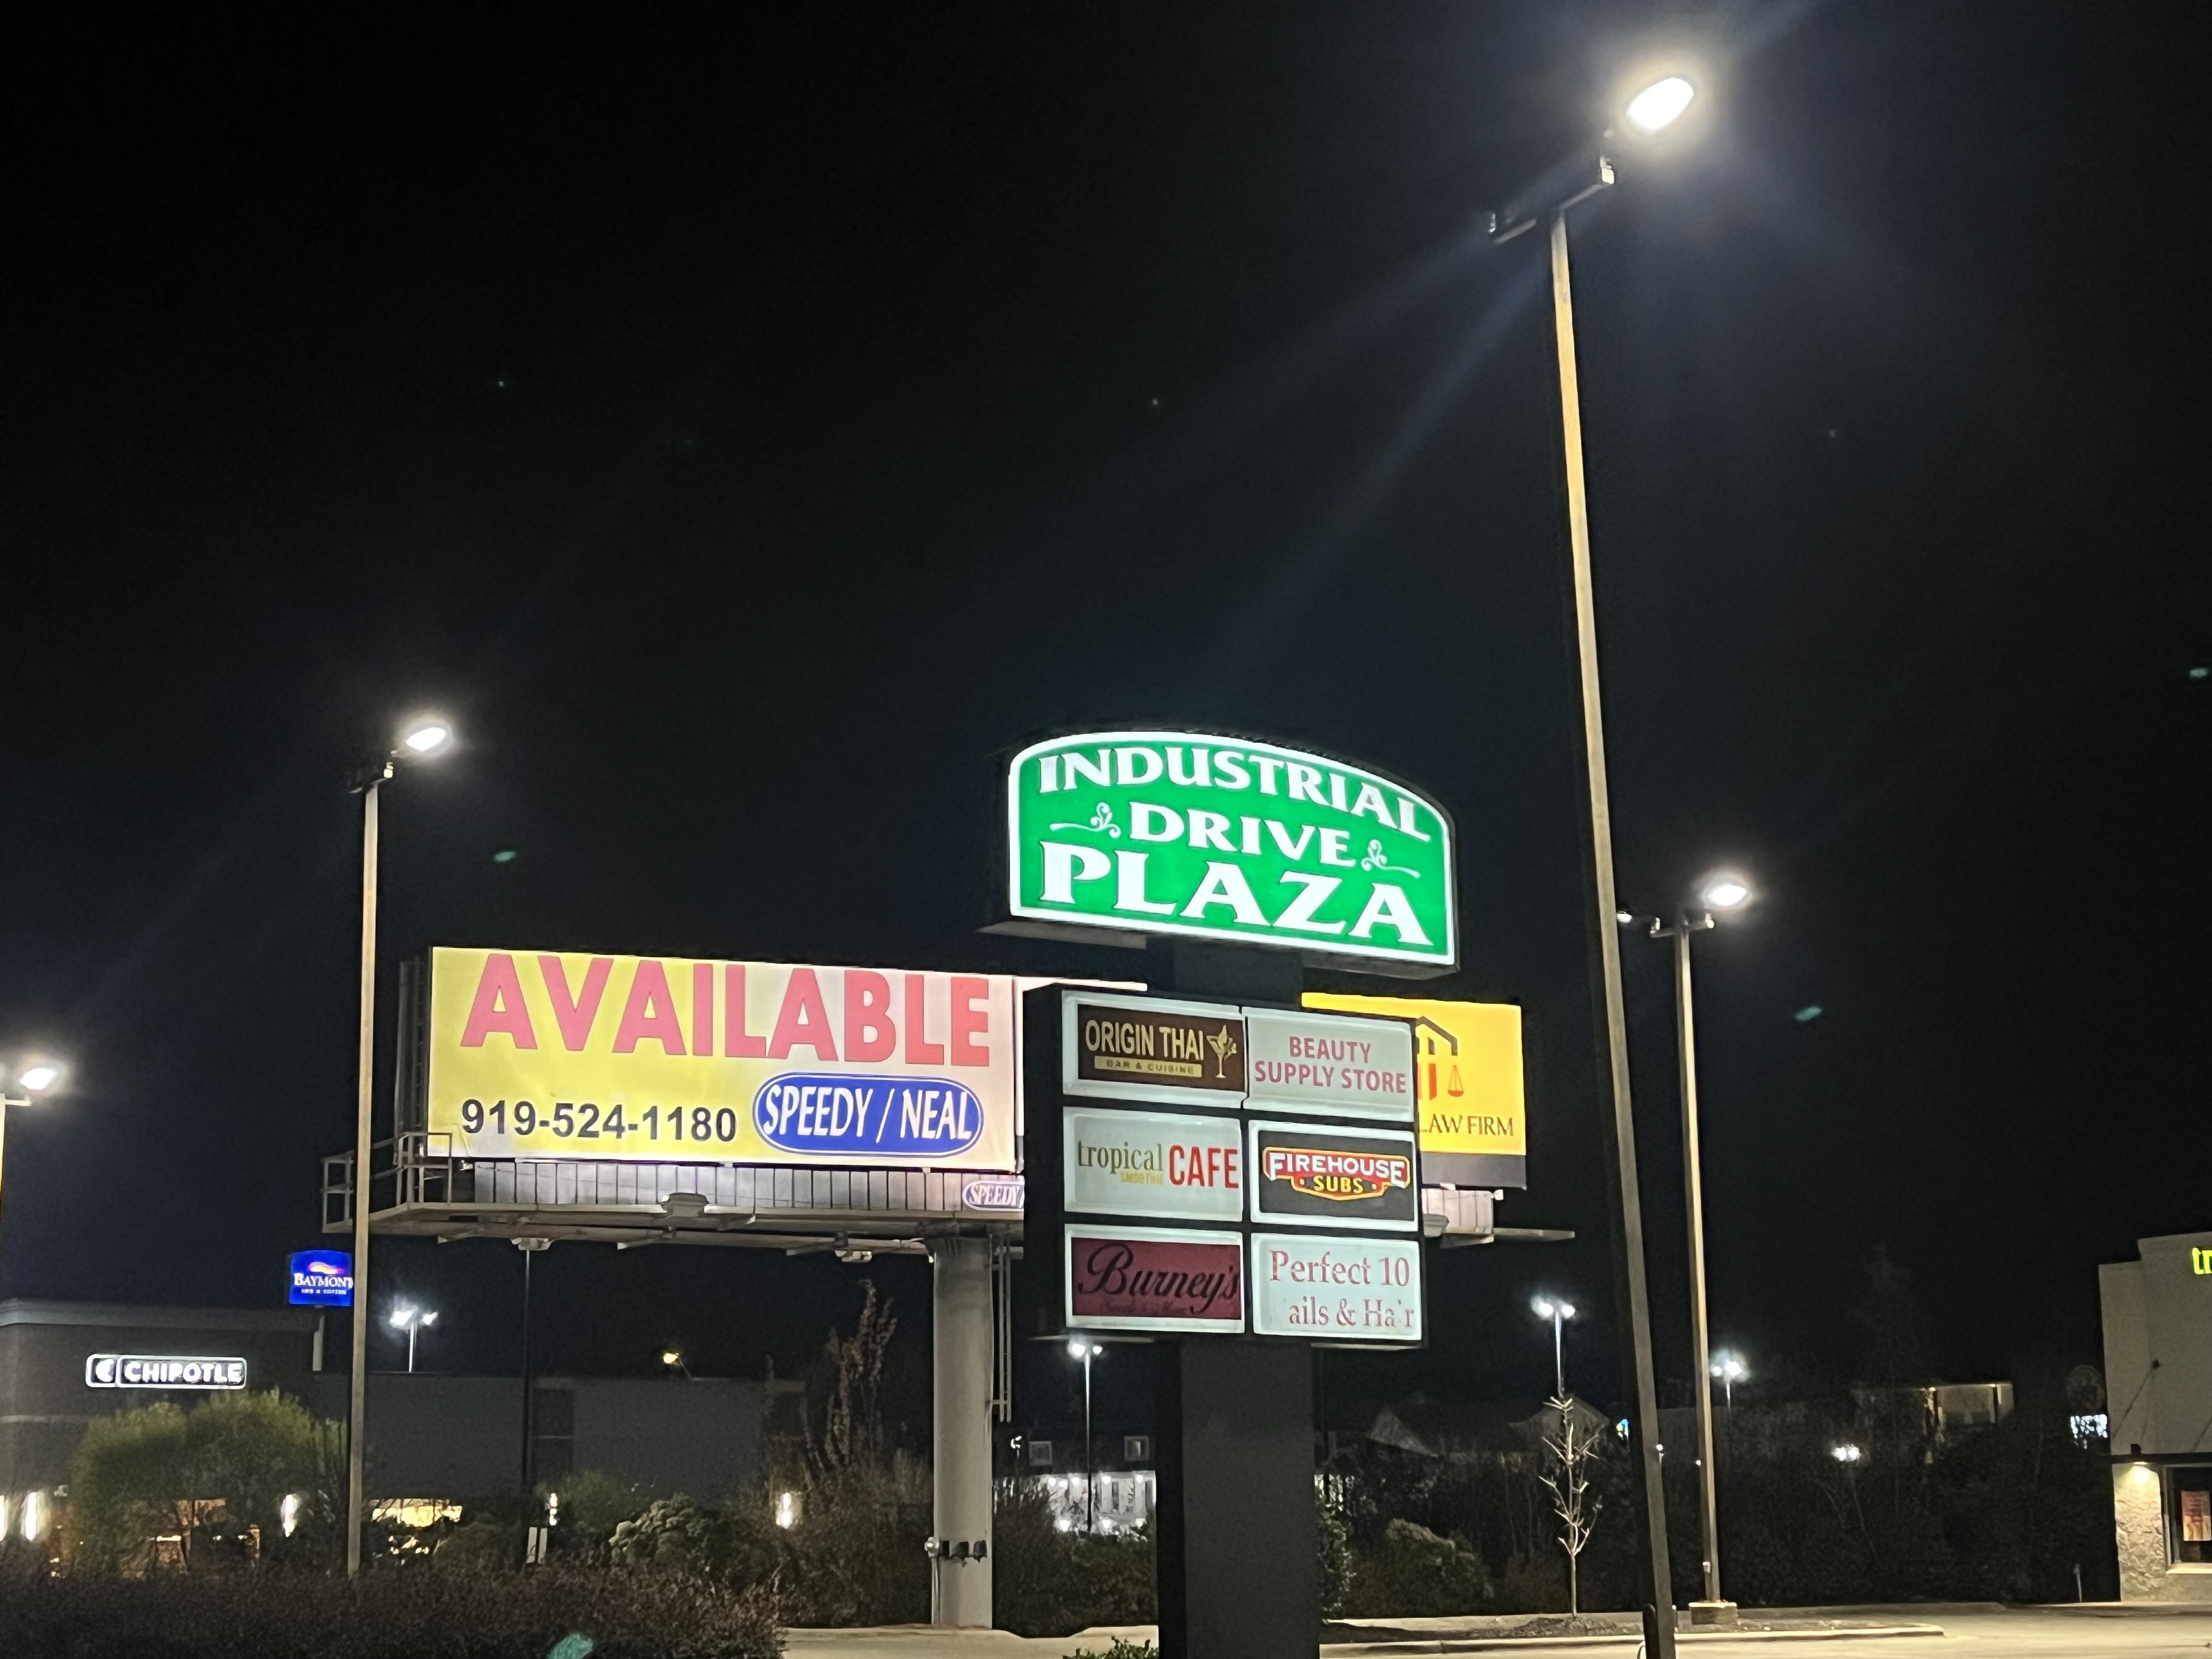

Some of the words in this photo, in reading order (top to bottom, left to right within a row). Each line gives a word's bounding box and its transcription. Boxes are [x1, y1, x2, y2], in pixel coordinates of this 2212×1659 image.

[1039, 746, 1430, 843] INDUSTRIAL
[1129, 802, 1356, 868] DRIVE
[1039, 841, 1434, 946] PLAZA
[460, 953, 990, 1066] AVAILABLE
[1085, 1019, 1154, 1056] ORIGIN
[1159, 1026, 1204, 1060] THAI
[1289, 1036, 1371, 1063] BEAUTY
[1255, 1060, 1334, 1087] SUPPLY
[1341, 1068, 1406, 1094] STORE
[461, 1099, 737, 1142] 919-524-1180
[763, 1084, 873, 1137] SPEEDY
[900, 1088, 972, 1140] NEAL
[1420, 1114, 1463, 1133] AW
[1467, 1115, 1514, 1136] FIRM
[1077, 1140, 1164, 1174] tropical
[1169, 1144, 1239, 1189] CAFE
[1269, 1152, 1407, 1188] FIREHOUSE
[968, 1184, 1020, 1206] SPEEDY
[1313, 1175, 1364, 1193] SUBS
[1077, 1242, 1239, 1314] Burney's
[1269, 1250, 1371, 1284] Perfect
[1379, 1257, 1409, 1286] 10
[1289, 1296, 1329, 1325] ails
[1336, 1298, 1356, 1327] &
[124, 1361, 243, 1383] CHIPOTLE
